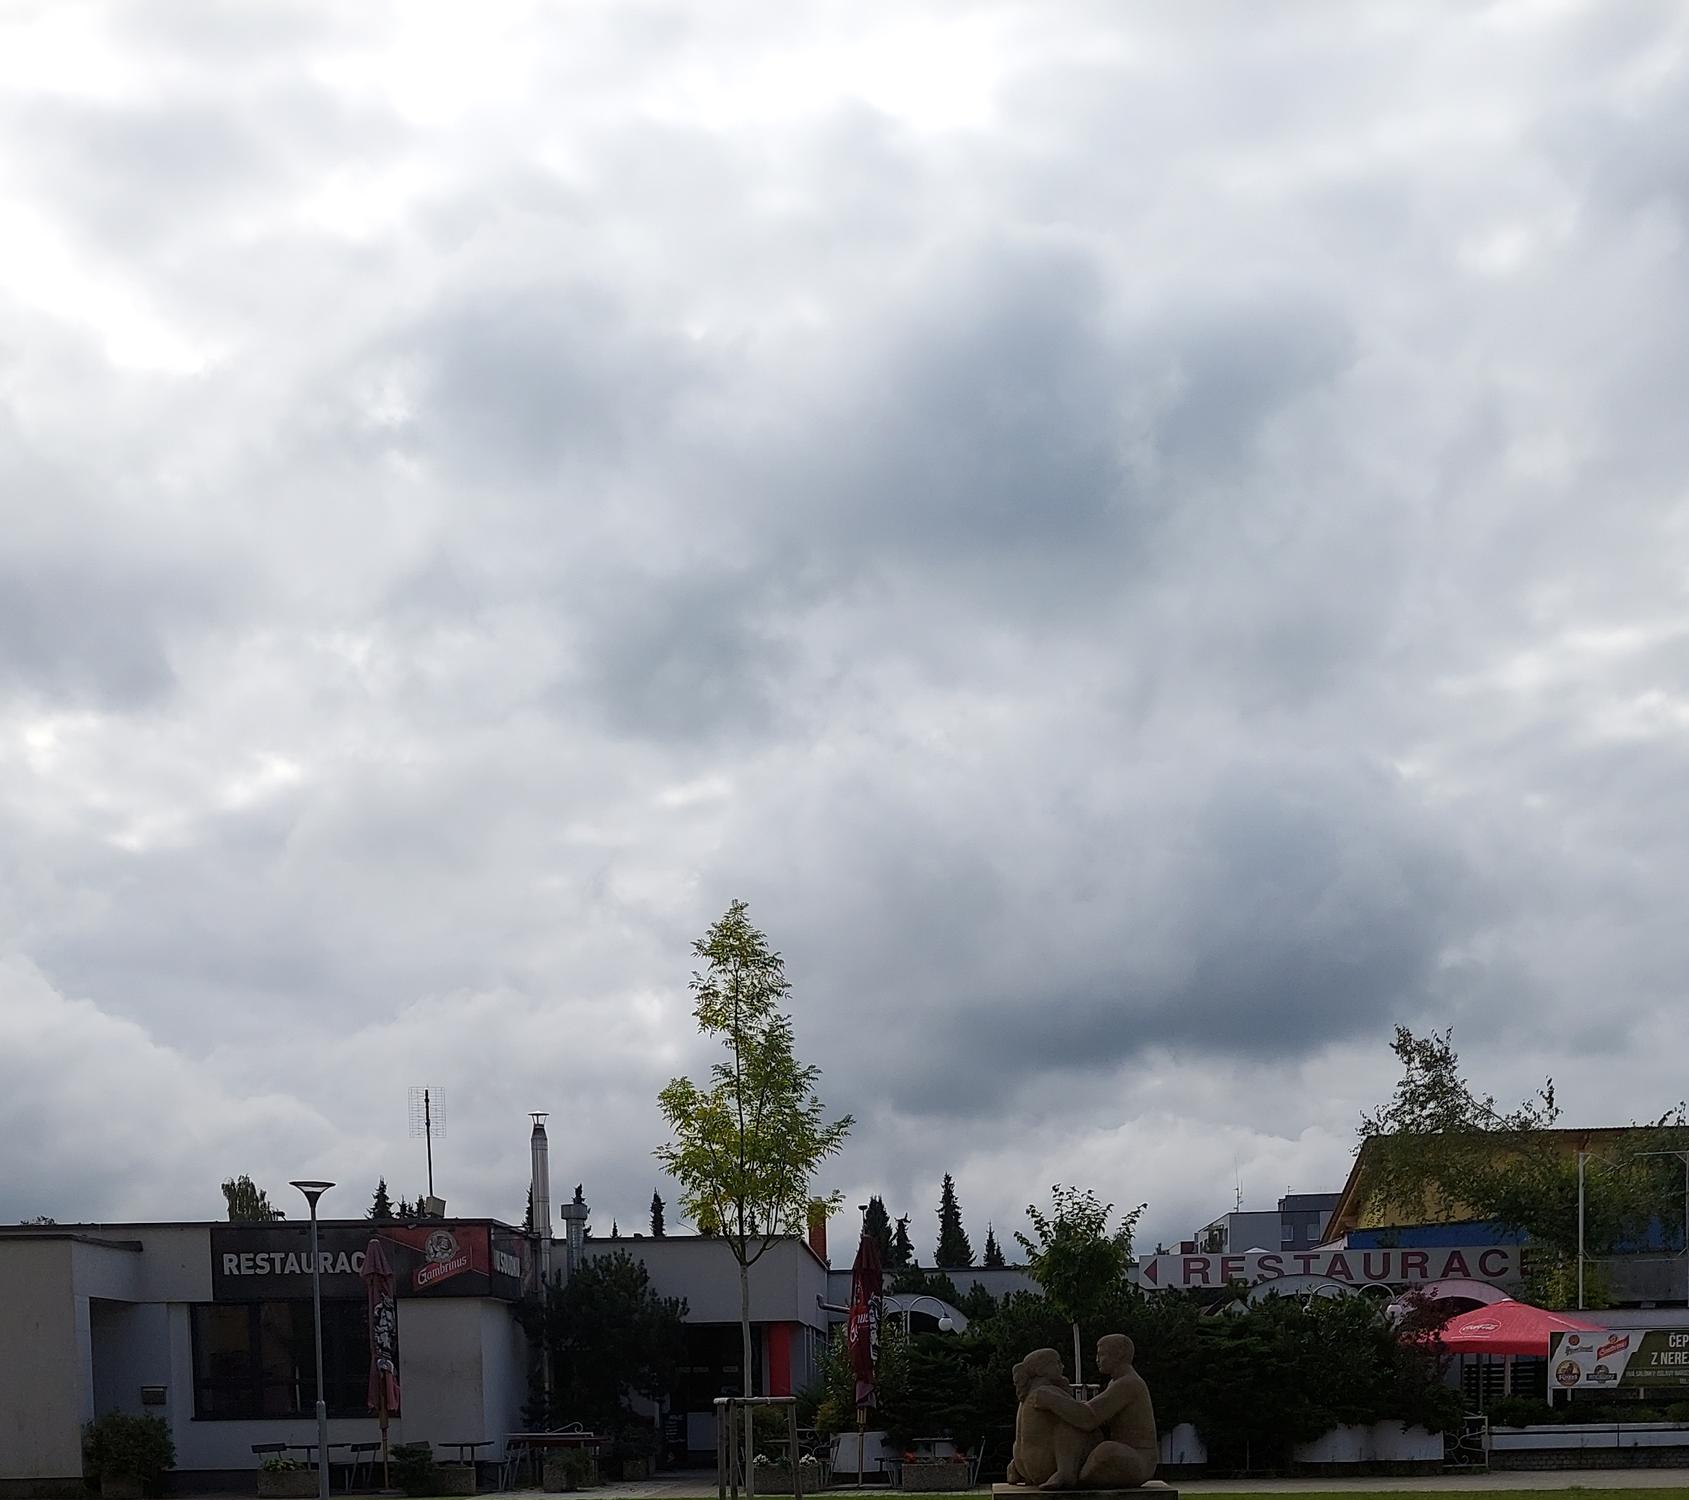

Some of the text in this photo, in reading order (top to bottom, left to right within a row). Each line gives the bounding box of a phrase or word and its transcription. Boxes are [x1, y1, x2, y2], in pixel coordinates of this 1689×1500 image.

[222, 1251, 366, 1275] RESTAURAC
[417, 1254, 469, 1285] Gambrinus
[1651, 1352, 1658, 1365] Z
